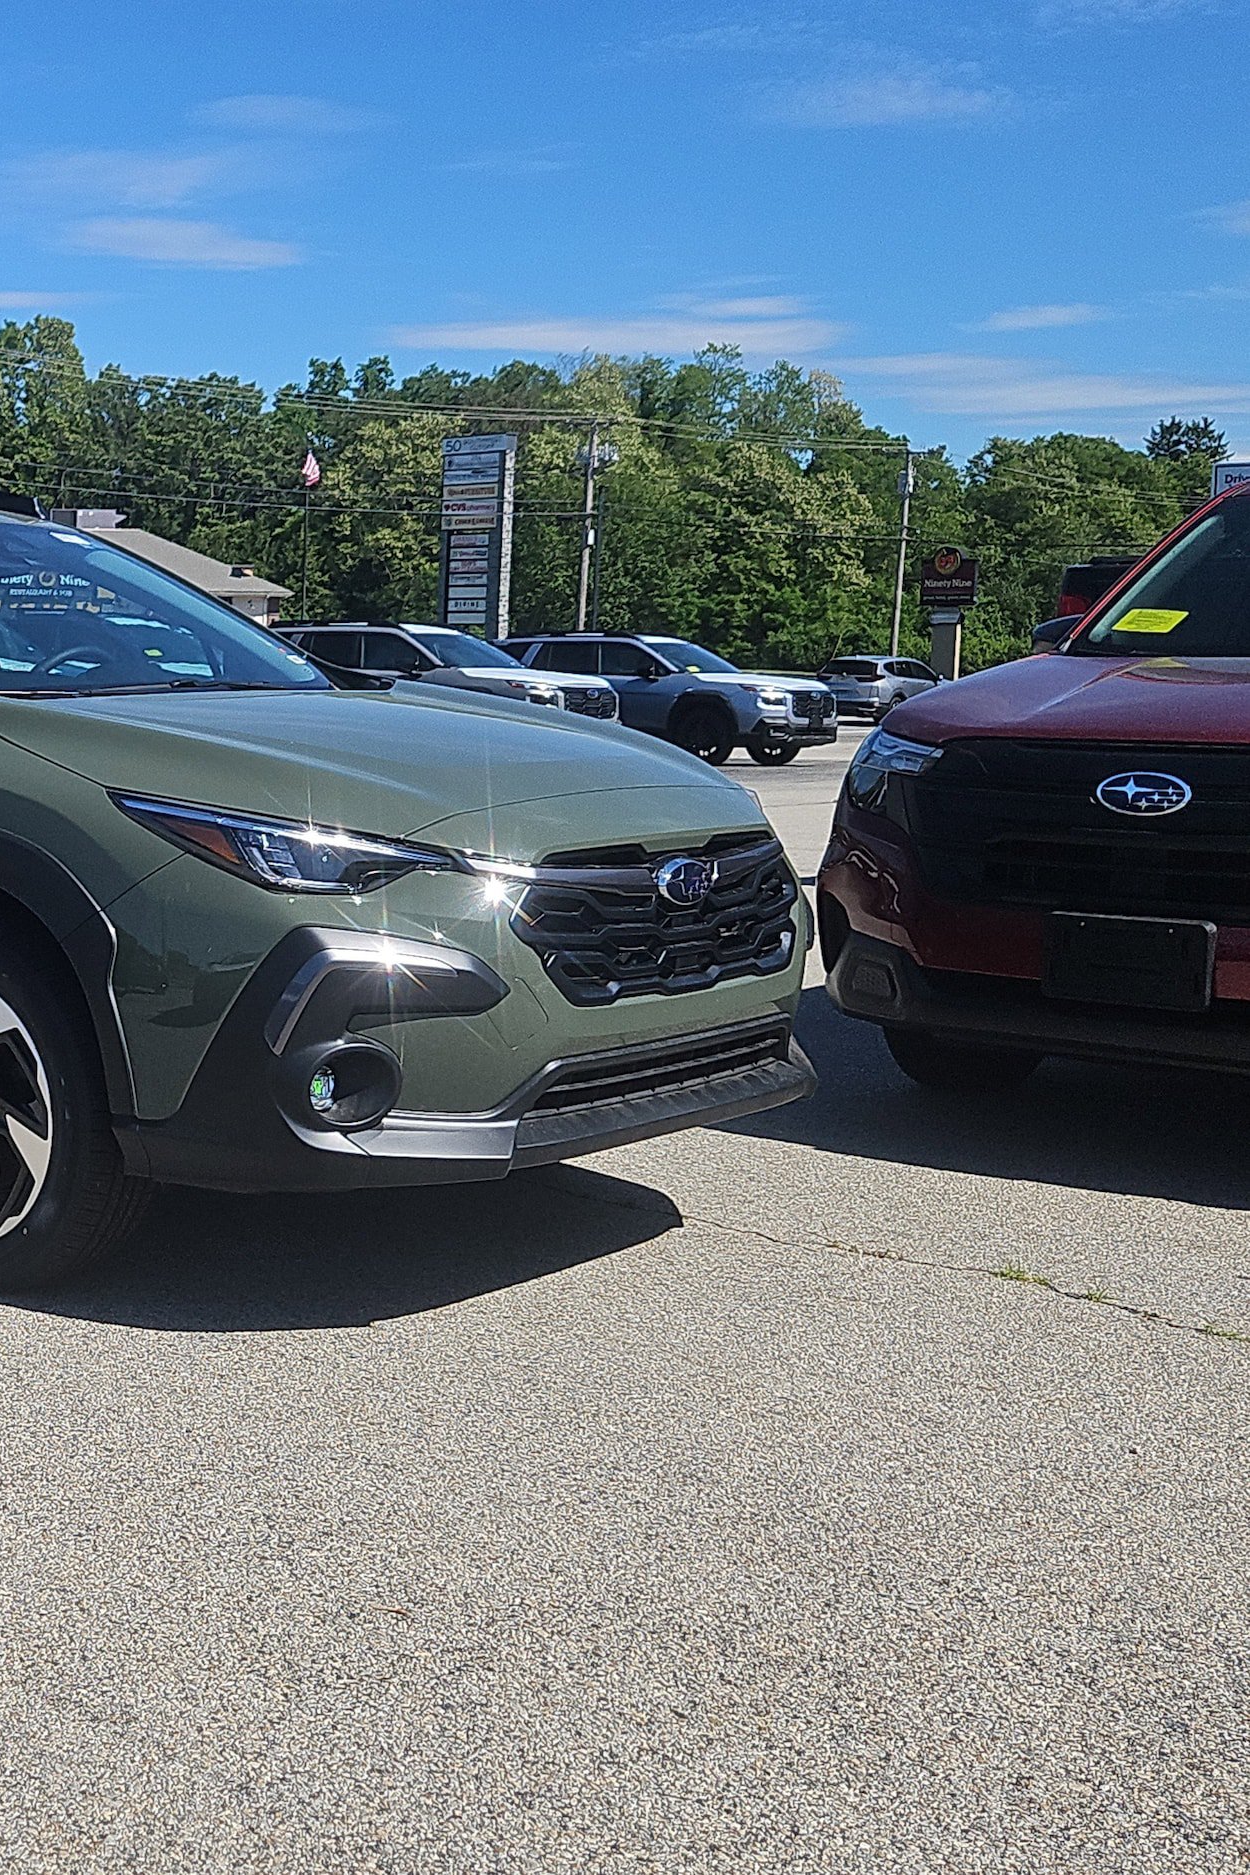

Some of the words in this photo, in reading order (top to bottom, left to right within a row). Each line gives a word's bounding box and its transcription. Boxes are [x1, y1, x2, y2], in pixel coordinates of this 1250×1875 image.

[445, 440, 461, 453] 50
[1225, 473, 1250, 484] Driv
[451, 503, 466, 511] CVS
[924, 579, 951, 588] Ninety
[952, 579, 972, 587] Nine
